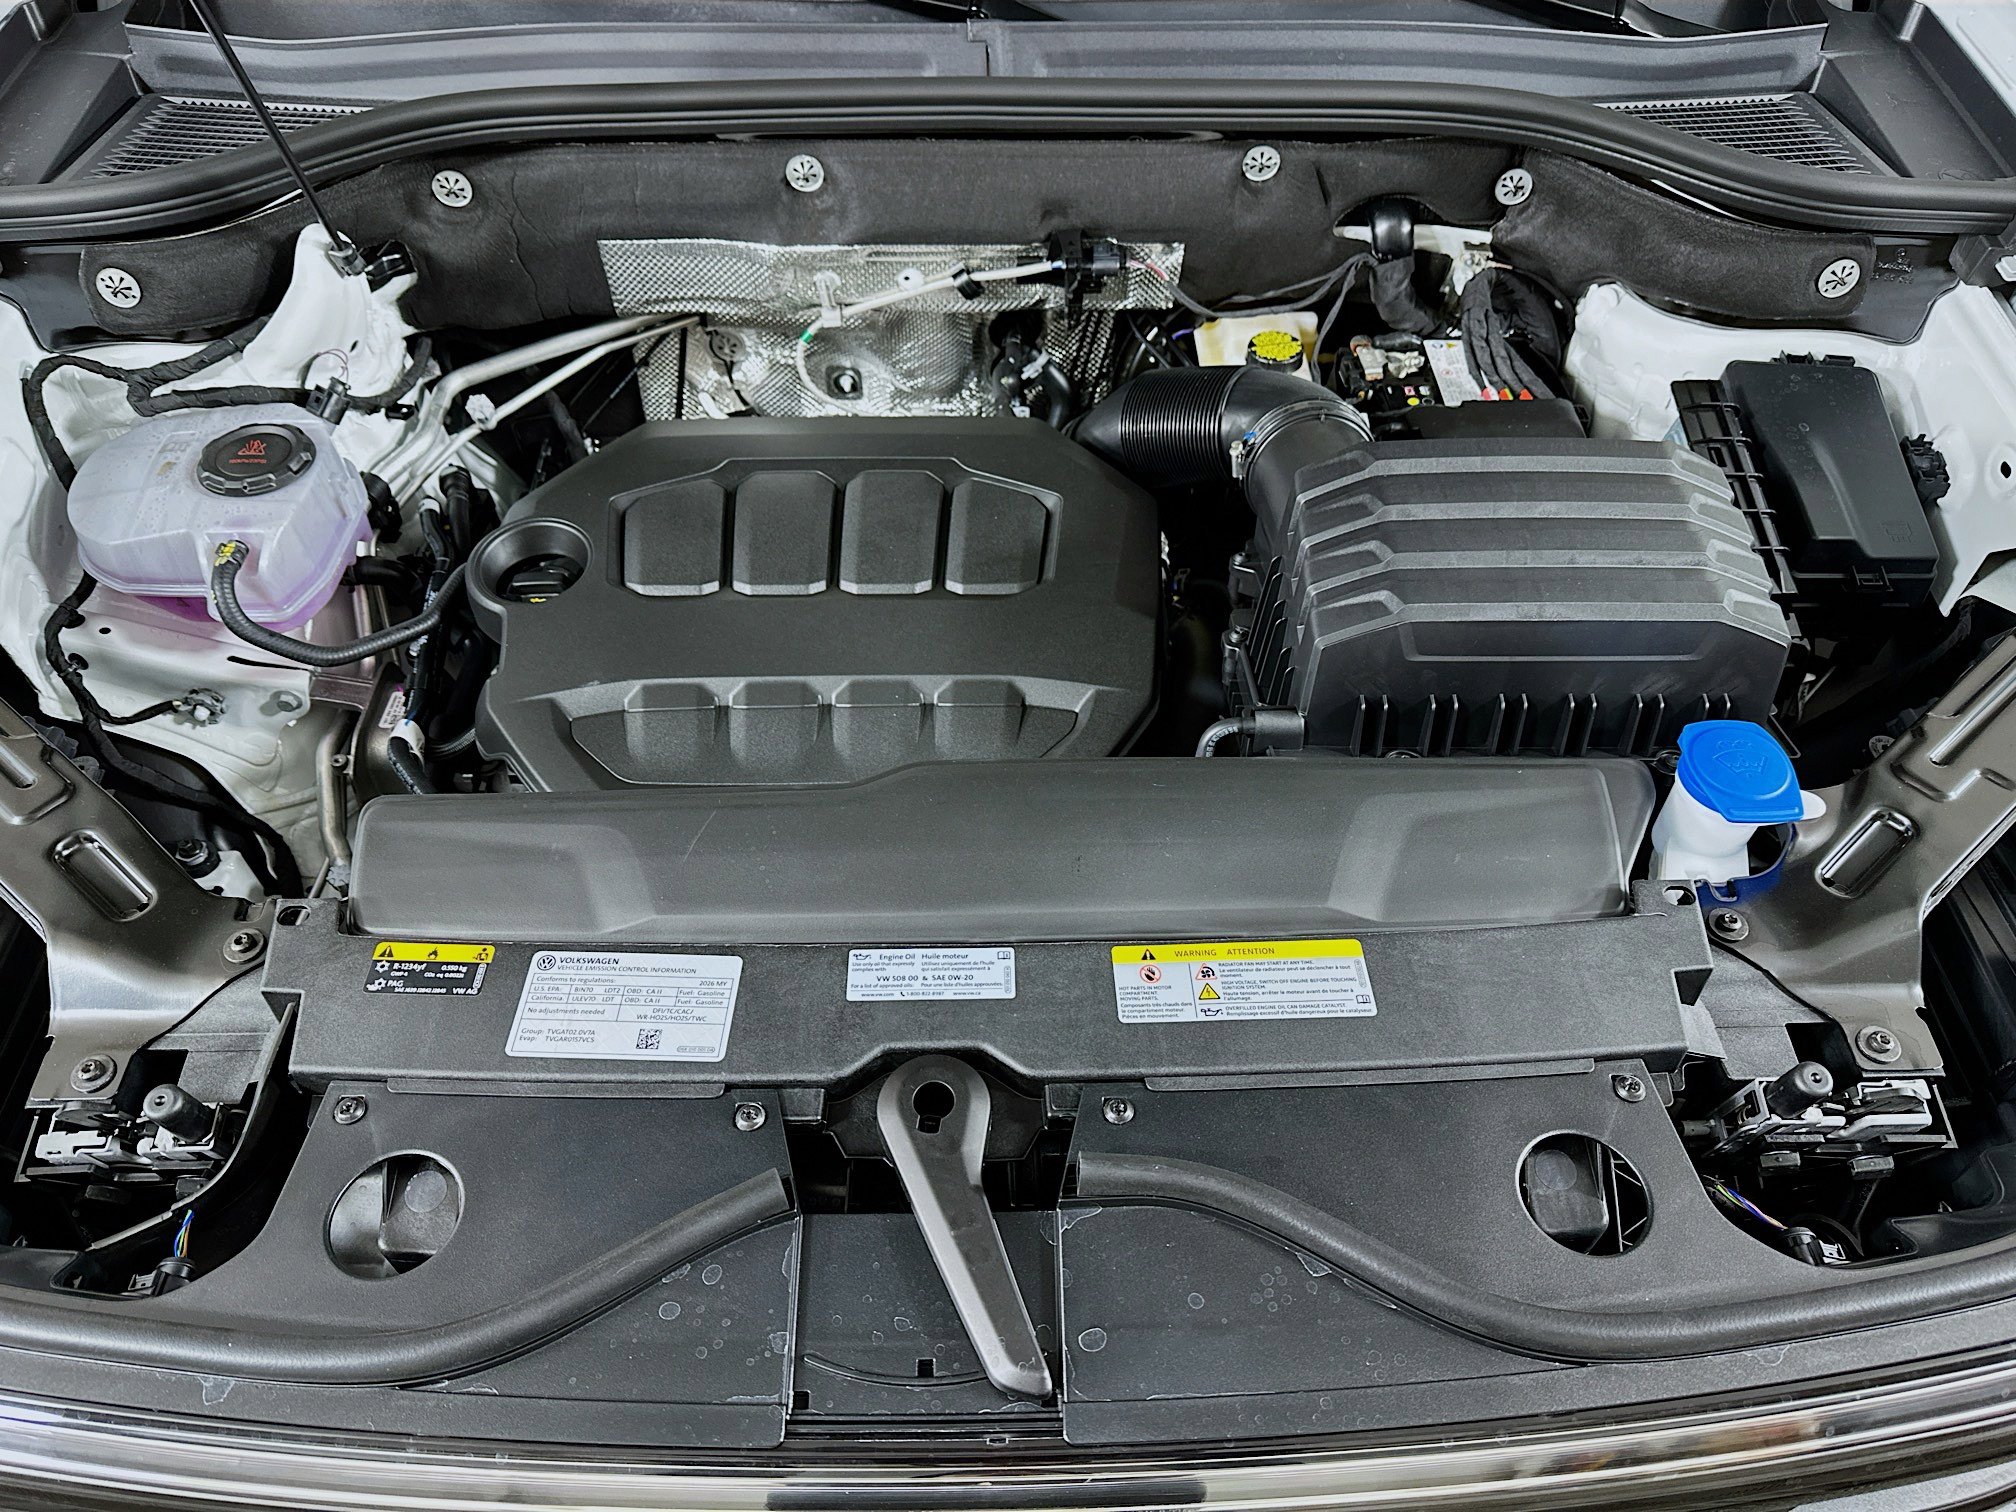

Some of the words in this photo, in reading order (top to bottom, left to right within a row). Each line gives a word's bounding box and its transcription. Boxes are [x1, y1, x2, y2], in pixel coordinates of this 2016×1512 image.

[1174, 949, 1217, 957] WARNING
[1227, 948, 1275, 956] ATTENTION
[560, 957, 620, 965] VOLKSWAGEN
[577, 977, 616, 985] regulations:
